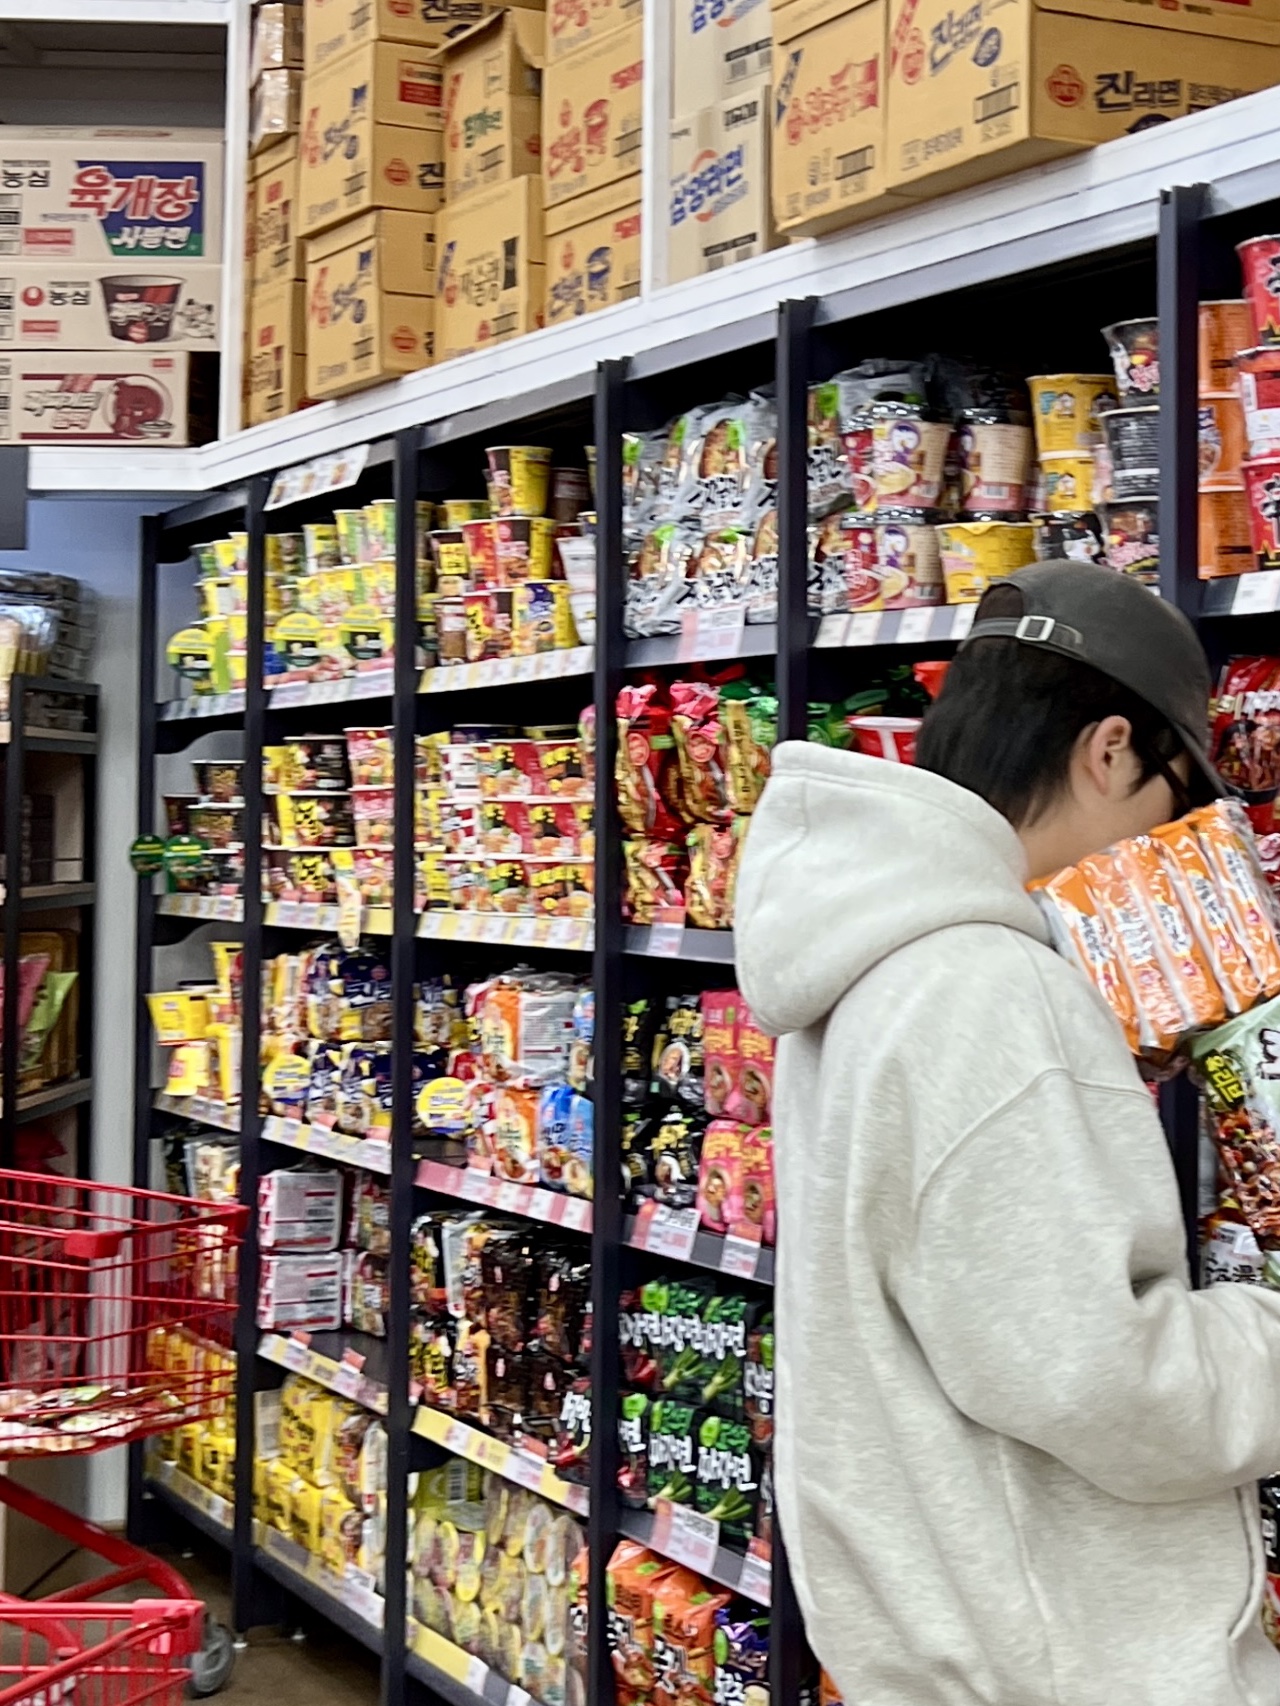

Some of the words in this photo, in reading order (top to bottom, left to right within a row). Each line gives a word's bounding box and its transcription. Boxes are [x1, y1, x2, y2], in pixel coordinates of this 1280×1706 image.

[1094, 70, 1183, 113] 진라면
[2, 170, 50, 188] 농심
[68, 166, 199, 221] 육개장
[111, 226, 192, 249] 사발면
[48, 289, 91, 306] 농심
